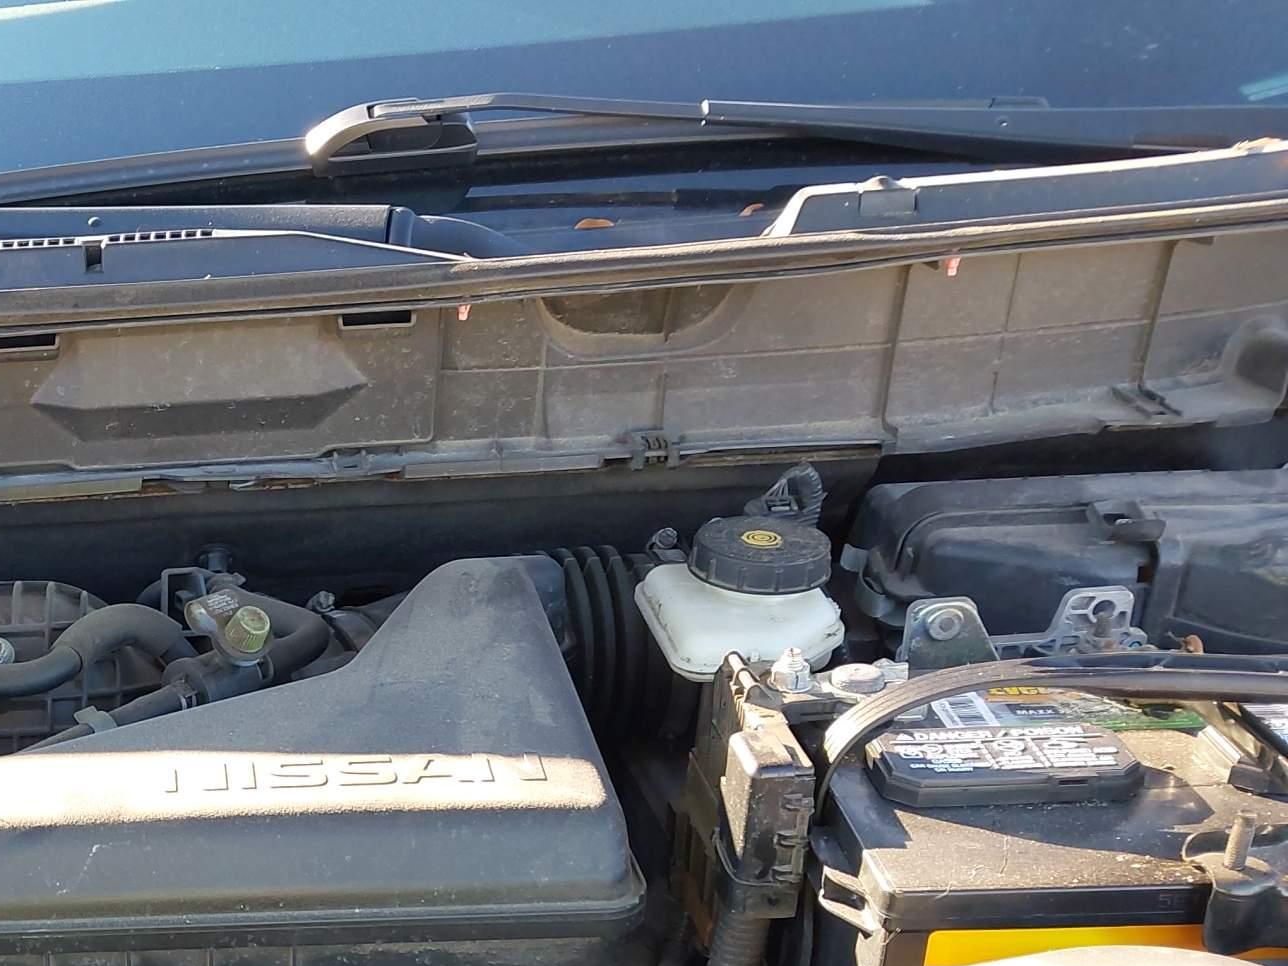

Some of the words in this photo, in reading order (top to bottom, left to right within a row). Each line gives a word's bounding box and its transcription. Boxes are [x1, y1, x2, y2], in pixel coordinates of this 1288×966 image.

[913, 730, 992, 741] DANGER
[1009, 725, 1085, 737] POISON
[162, 753, 548, 794] NISSAN
